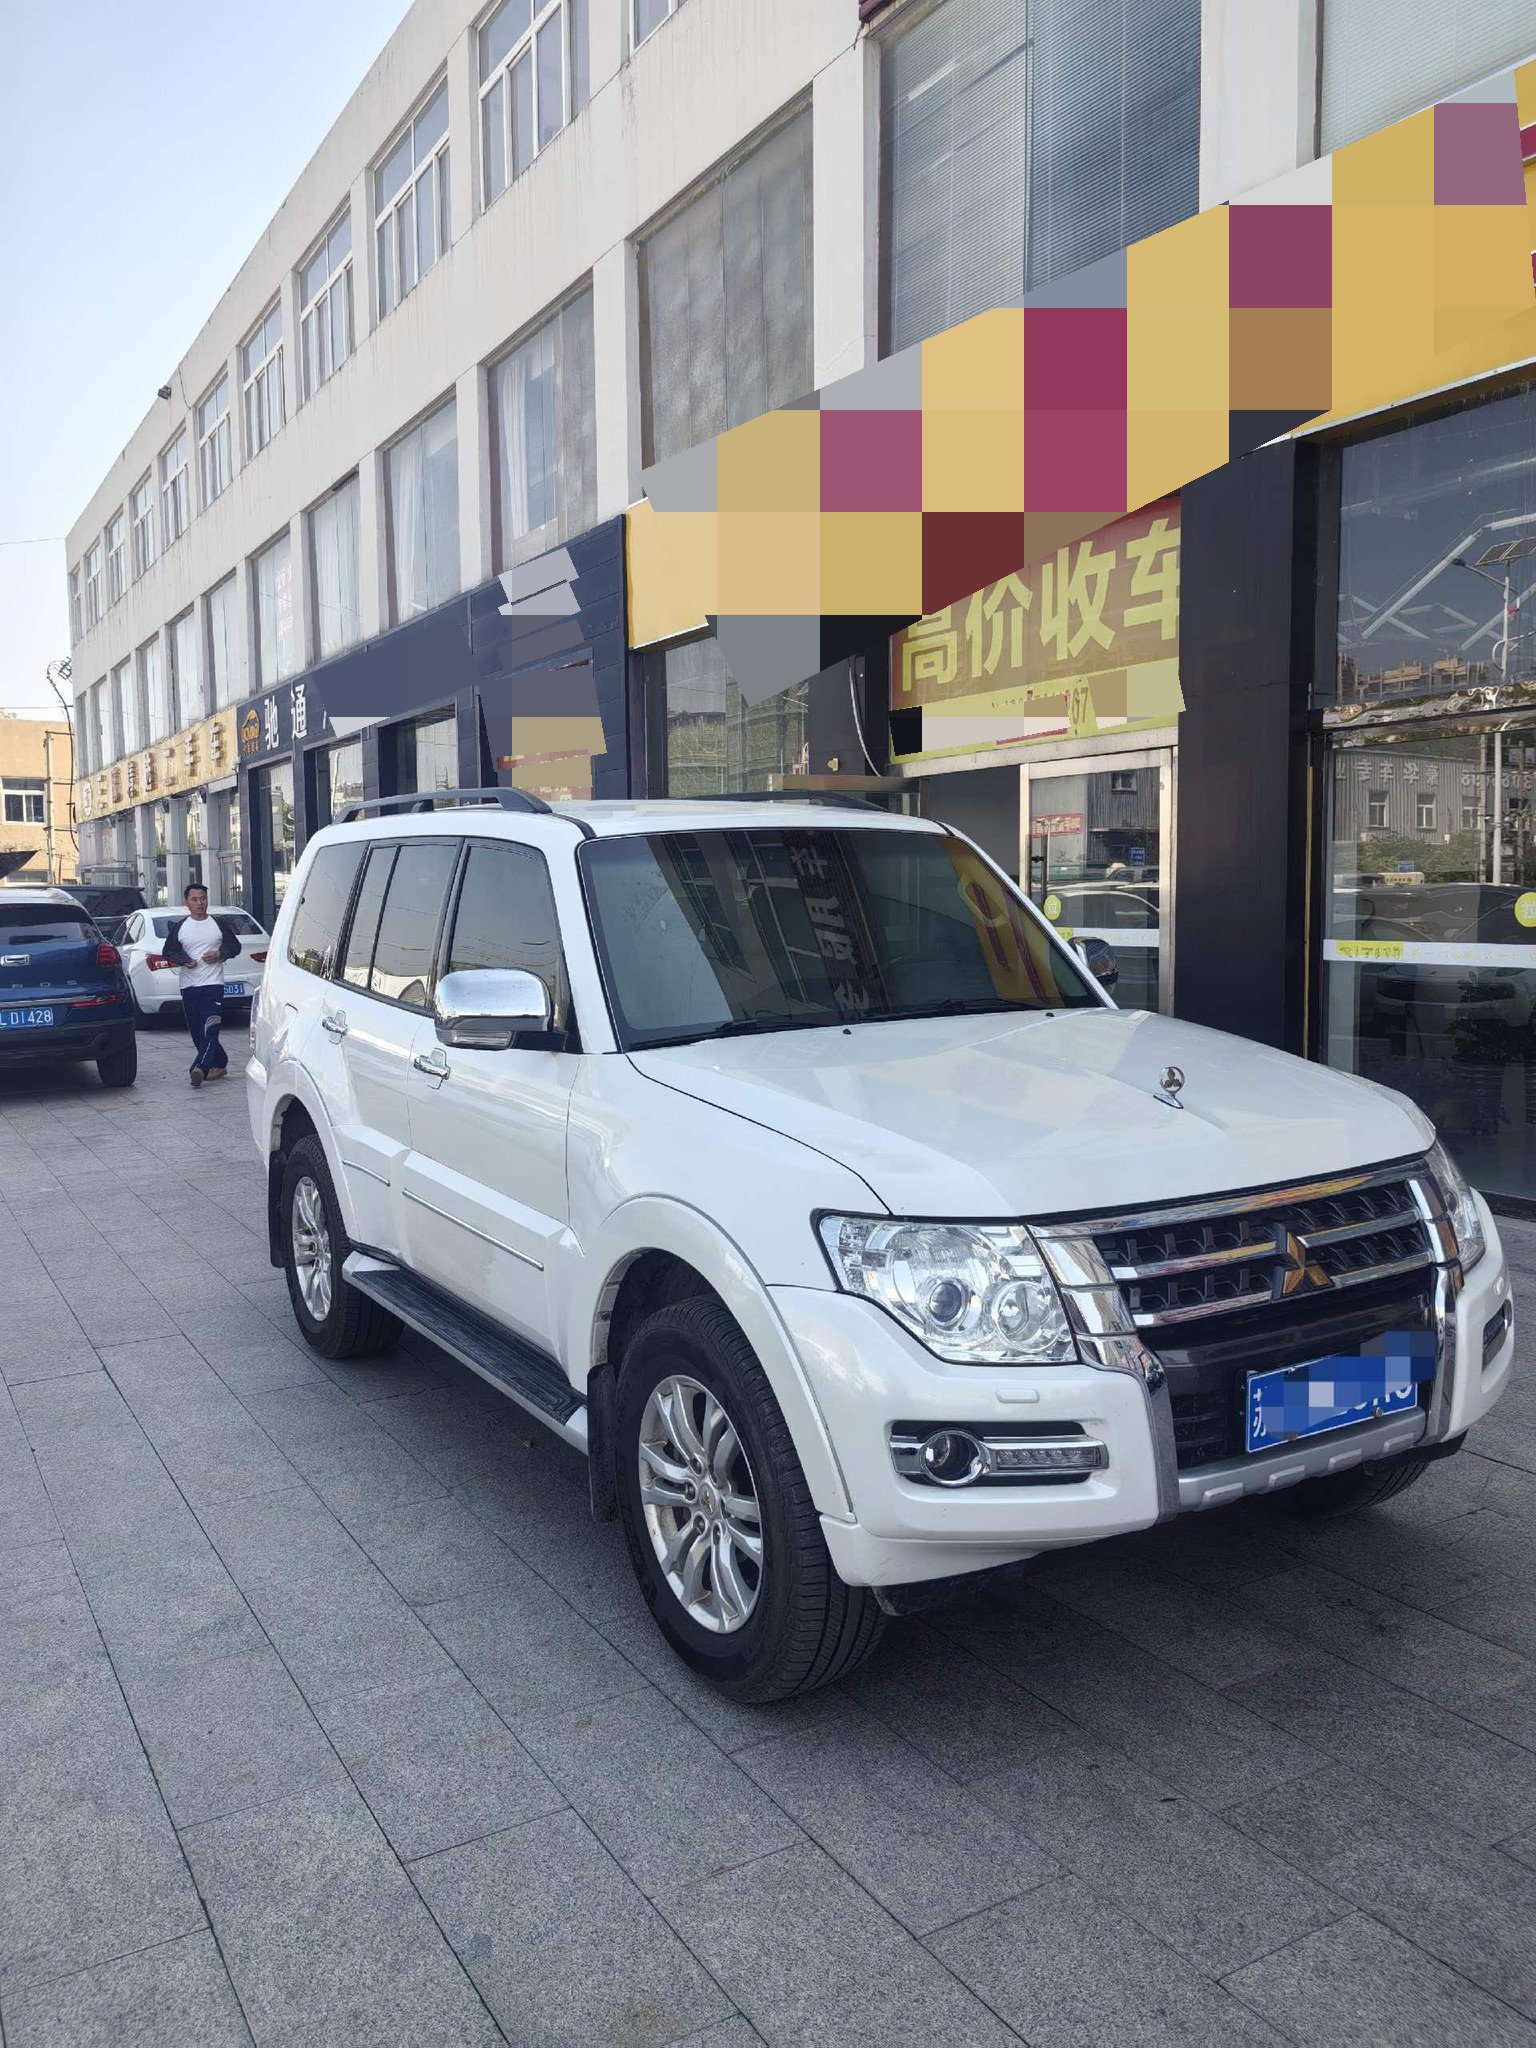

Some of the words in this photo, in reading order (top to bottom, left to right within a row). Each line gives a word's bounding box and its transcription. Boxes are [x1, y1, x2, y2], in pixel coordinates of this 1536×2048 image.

[902, 517, 1181, 692] 高价收车
[264, 683, 308, 750] 驰通
